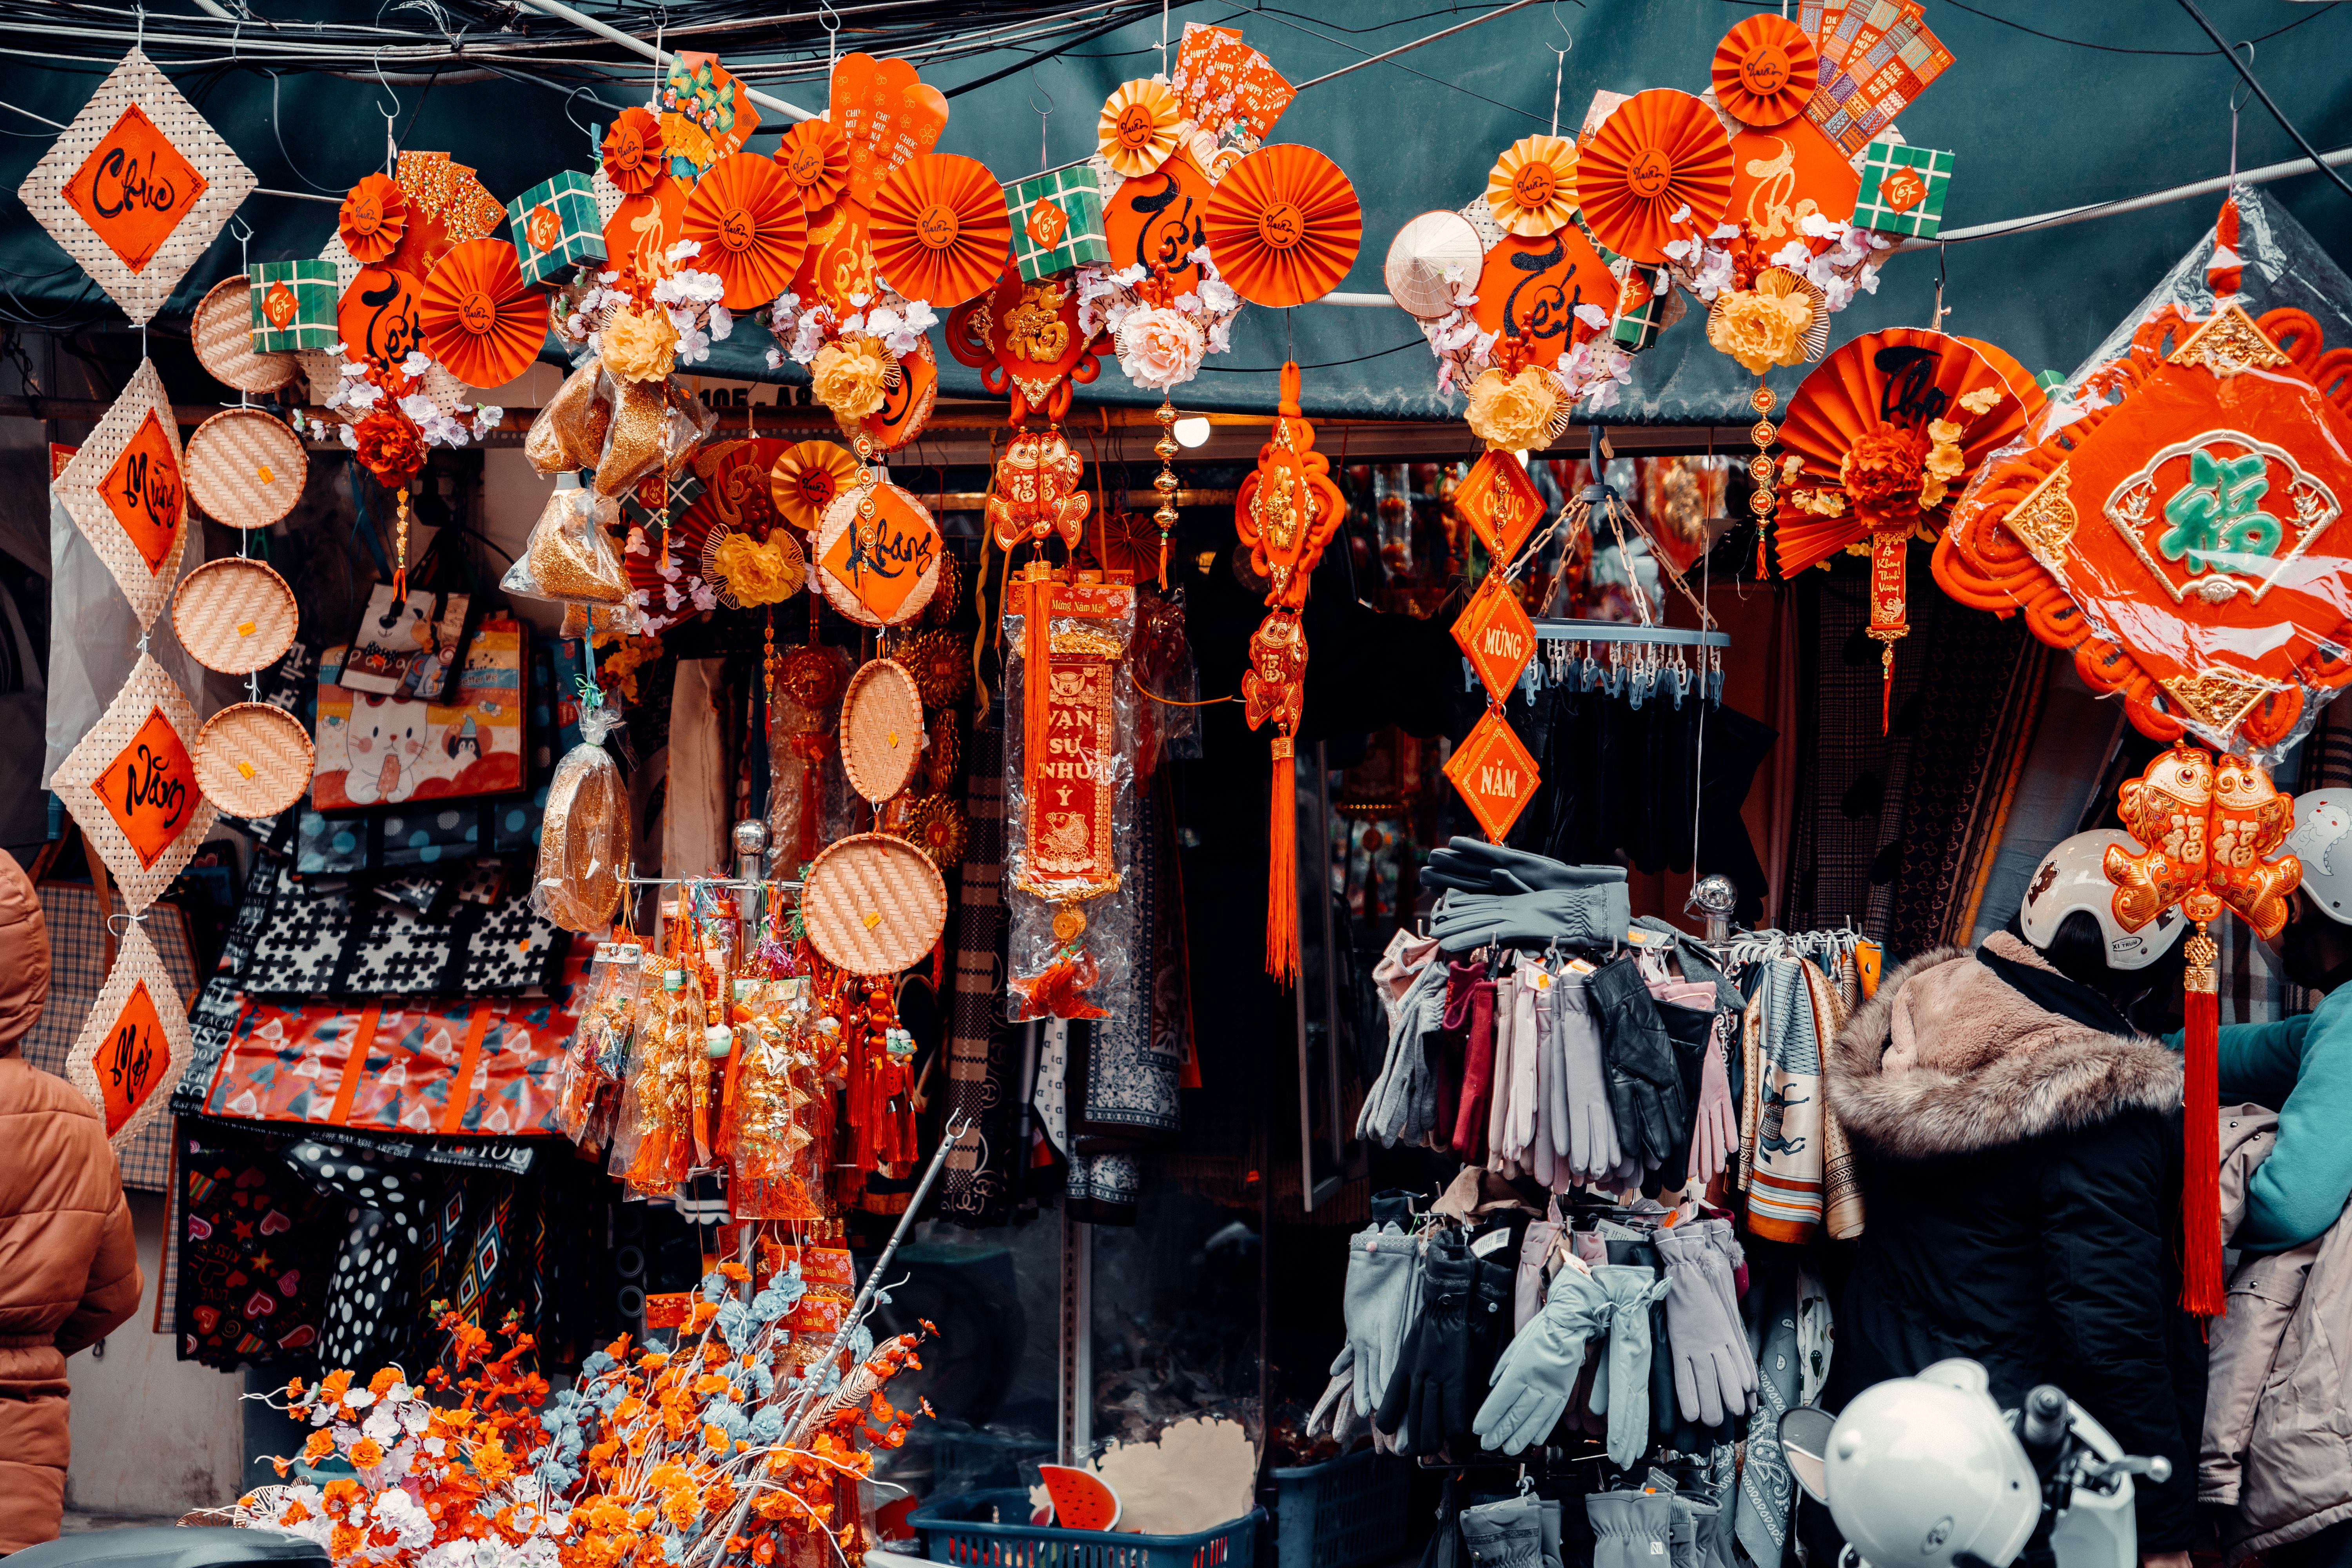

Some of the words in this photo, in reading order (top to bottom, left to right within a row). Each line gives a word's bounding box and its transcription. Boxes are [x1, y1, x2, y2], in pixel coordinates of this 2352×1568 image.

[1214, 60, 1234, 73] HAPPY
[1889, 62, 1904, 78] CHÚC
[1243, 80, 1263, 96] HAPPY
[1246, 95, 1260, 111] NEW
[1250, 115, 1265, 131] YEAR
[728, 132, 741, 147] HAPPY
[899, 133, 918, 149] CHÚC
[894, 142, 913, 159] MỪNG
[93, 147, 175, 218] Chúc
[122, 452, 175, 528] Mừng
[1011, 474, 1037, 503] 福
[2158, 449, 2283, 575] 福
[845, 518, 933, 588] Khang
[1883, 546, 1895, 557] An
[1877, 558, 1900, 575] Khang
[1878, 571, 1899, 581] Thịnh
[1878, 582, 1899, 596] Vượng
[1052, 599, 1071, 612] Mừng
[1074, 601, 1090, 612] Năm
[1091, 603, 1104, 613] Mới
[1485, 626, 1522, 660] MỪNG
[1049, 735, 1082, 757] SỰ
[125, 744, 185, 828] Năm
[1481, 759, 1517, 798] NĂM
[1056, 784, 1073, 806] Ý
[2161, 814, 2206, 864] 福
[2213, 819, 2259, 868] 福
[815, 1266, 827, 1277] Năm
[827, 1269, 837, 1278] Mới
